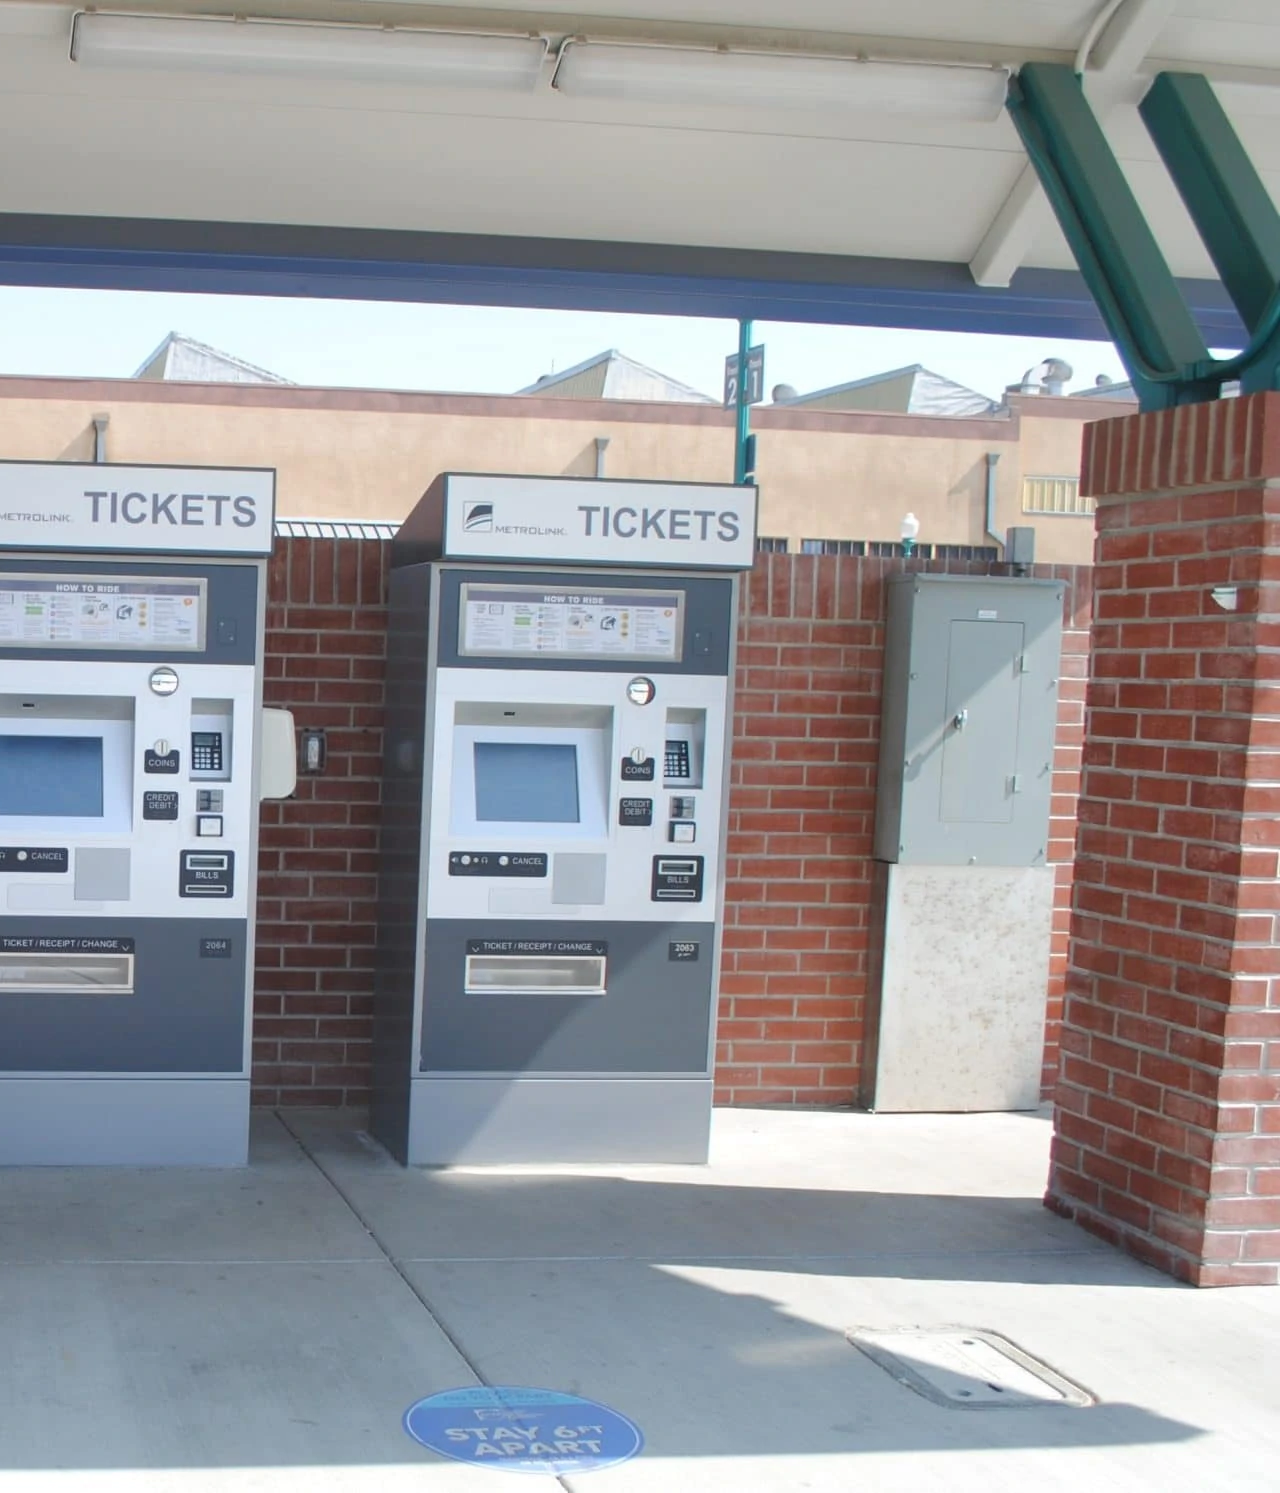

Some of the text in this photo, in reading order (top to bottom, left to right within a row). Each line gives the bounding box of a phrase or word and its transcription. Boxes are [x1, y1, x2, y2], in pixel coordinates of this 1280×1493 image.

[84, 491, 257, 528] TICKETS
[578, 505, 740, 542] TICKETS
[495, 525, 566, 536] METROLINK
[56, 583, 120, 593] HOW TO RIDE
[544, 595, 604, 605] HOW TO RIDE
[148, 759, 176, 768] COINS
[625, 767, 651, 775] COINS
[146, 794, 176, 802] CREDIT
[622, 800, 651, 808] CREDIT
[624, 808, 646, 816] DEBIT
[31, 852, 64, 861] CANCEL
[512, 857, 543, 866] CANCEL
[195, 871, 219, 880] BILLS
[667, 876, 689, 884] BILLS
[3, 938, 32, 948] TICKET
[40, 939, 75, 949] RECEIPT
[82, 939, 118, 949] CHANGE
[483, 941, 512, 951] TICKET
[518, 942, 552, 951] RECEIPT
[558, 942, 592, 951] CHANGE
[444, 1426, 538, 1441] STAY
[474, 1440, 601, 1456] APART
